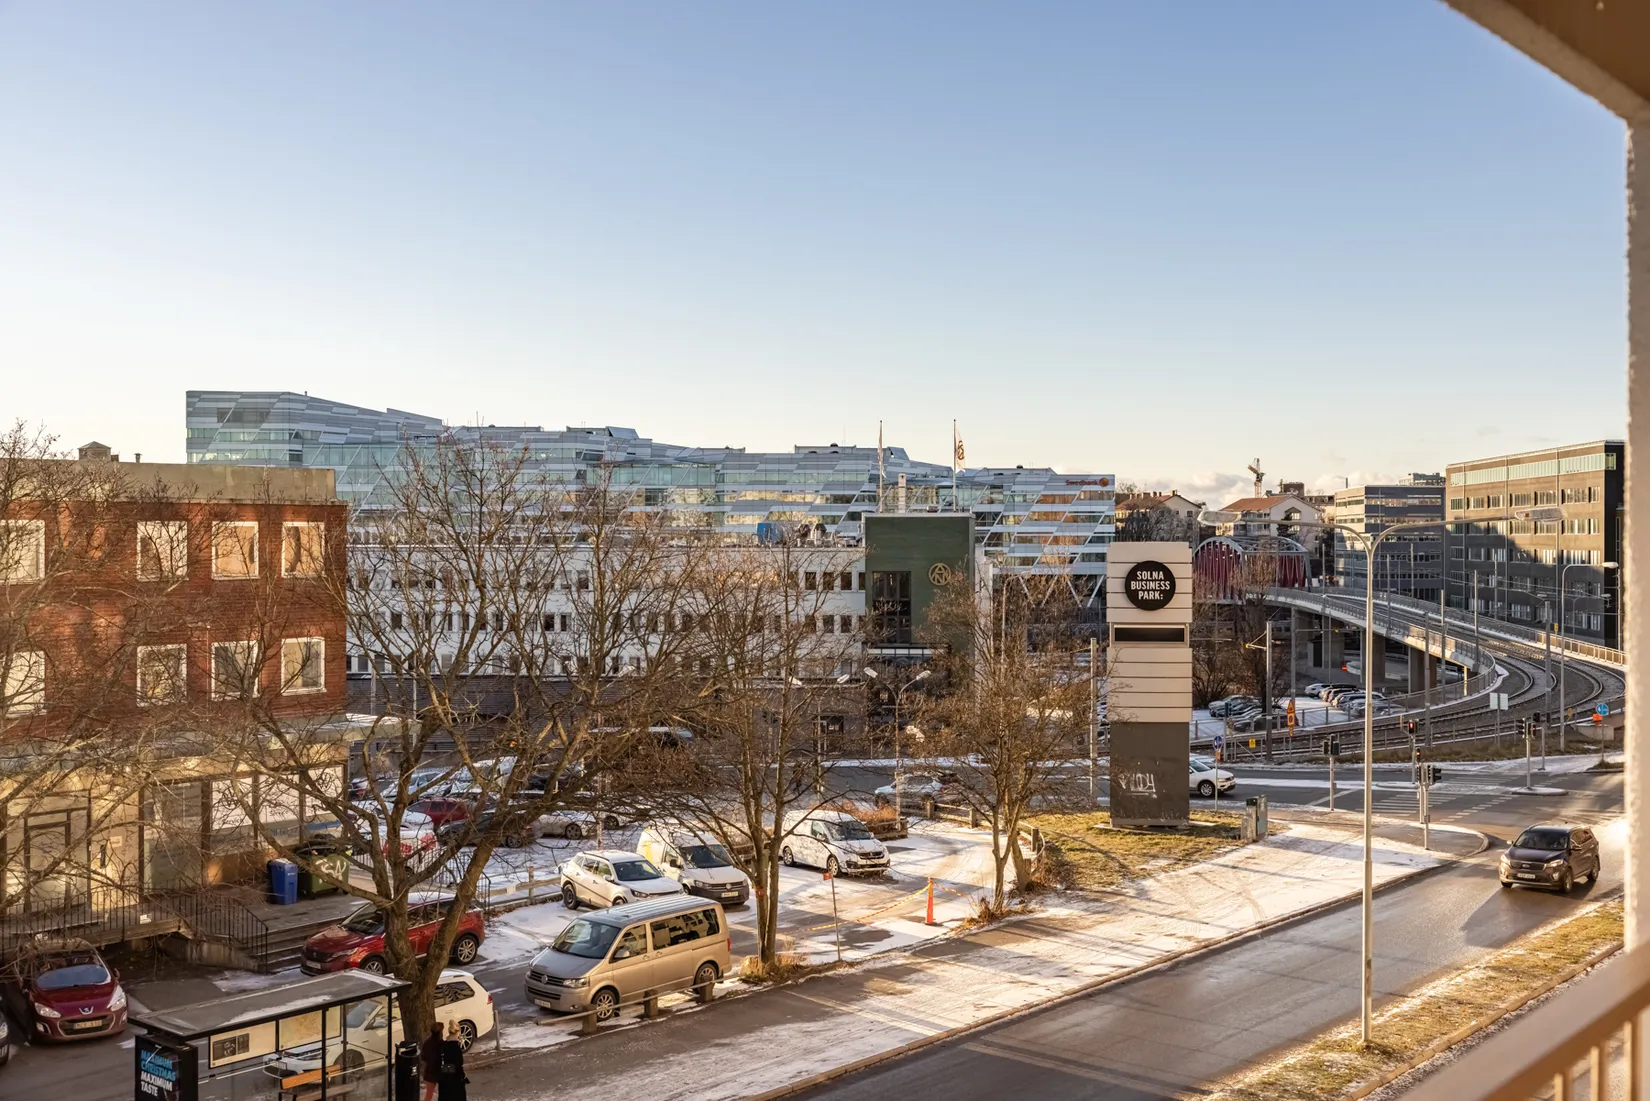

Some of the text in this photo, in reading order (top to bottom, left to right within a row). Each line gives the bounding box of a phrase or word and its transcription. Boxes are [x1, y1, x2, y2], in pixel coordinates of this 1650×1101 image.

[1136, 571, 1164, 580] SOLNA
[1130, 581, 1171, 590] BUSINESS
[1138, 591, 1164, 600] PARK:
[141, 1050, 172, 1071] MAXIMUM
[141, 1060, 176, 1081] CHRISTMAS
[141, 1071, 172, 1091] MAXIMUM
[141, 1081, 158, 1096] TASTE
